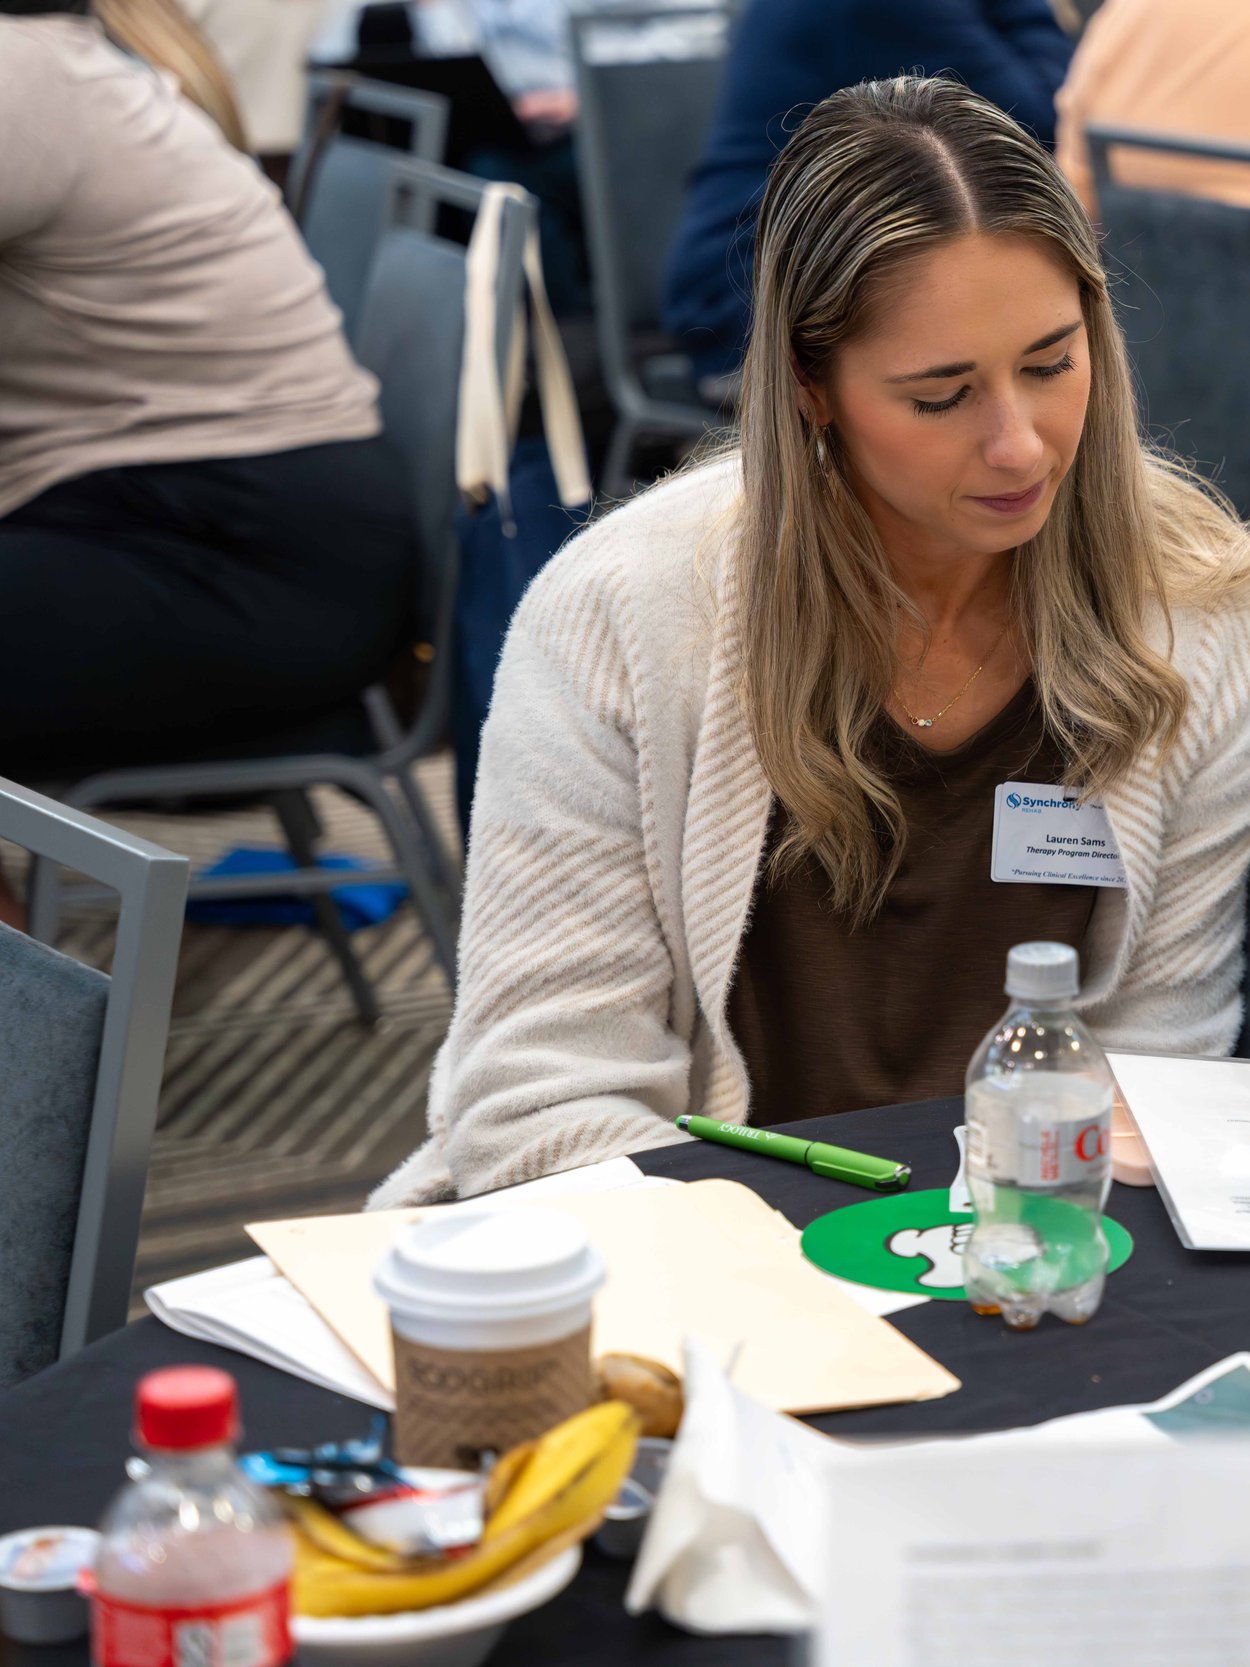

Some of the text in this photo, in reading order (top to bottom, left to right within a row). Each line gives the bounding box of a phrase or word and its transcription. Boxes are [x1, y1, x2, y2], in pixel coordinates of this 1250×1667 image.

[1046, 834, 1106, 847] Lauren Sams
[1026, 846, 1056, 856] Therapy
[1057, 849, 1090, 858] Program
[1043, 871, 1066, 879] Clinical
[1067, 873, 1099, 881] Excellence
